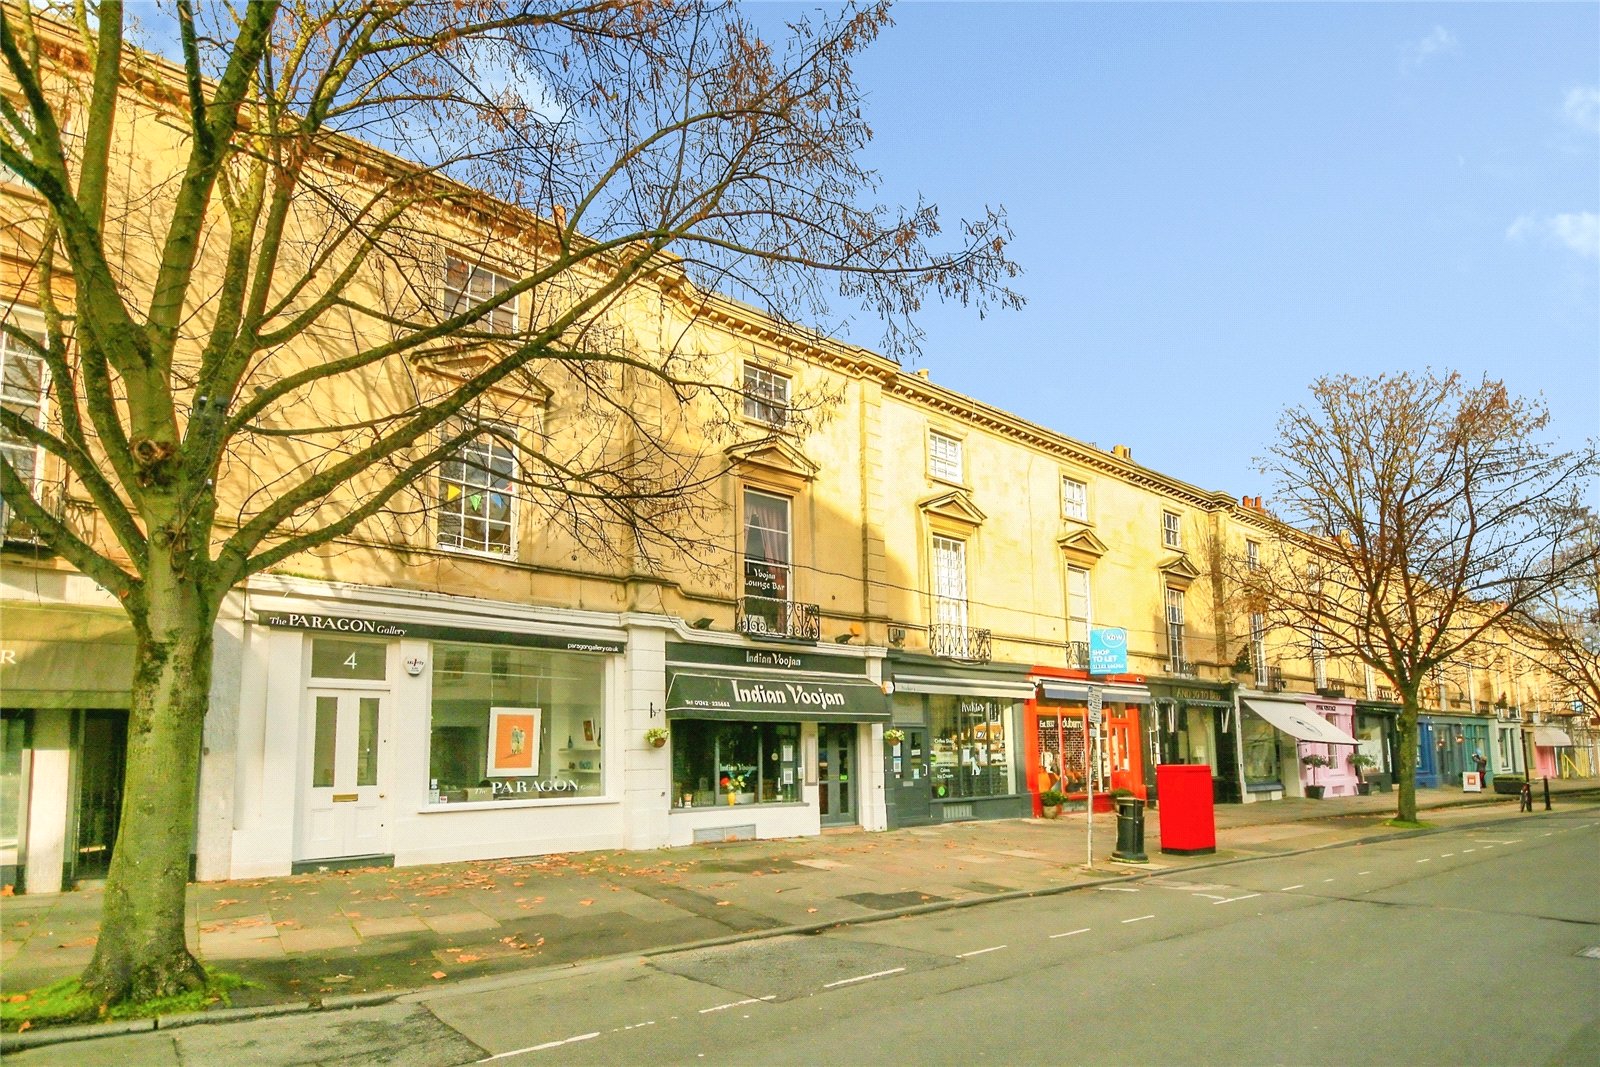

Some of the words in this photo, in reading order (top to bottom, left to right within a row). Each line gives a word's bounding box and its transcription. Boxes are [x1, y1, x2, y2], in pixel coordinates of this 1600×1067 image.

[753, 567, 776, 581] Voojan
[772, 582, 785, 590] Bar
[269, 615, 287, 626] The
[289, 613, 376, 633] PARAGON
[376, 625, 407, 637] Gallery
[746, 650, 772, 664] Indian
[771, 652, 801, 668] Voojan
[1092, 648, 1110, 656] SHOP
[1093, 655, 1103, 663] TO
[1103, 655, 1118, 663] LET
[343, 651, 358, 670] 4
[731, 679, 787, 705] Indian
[785, 683, 845, 710] Voojan
[491, 779, 579, 794] PARAGON
